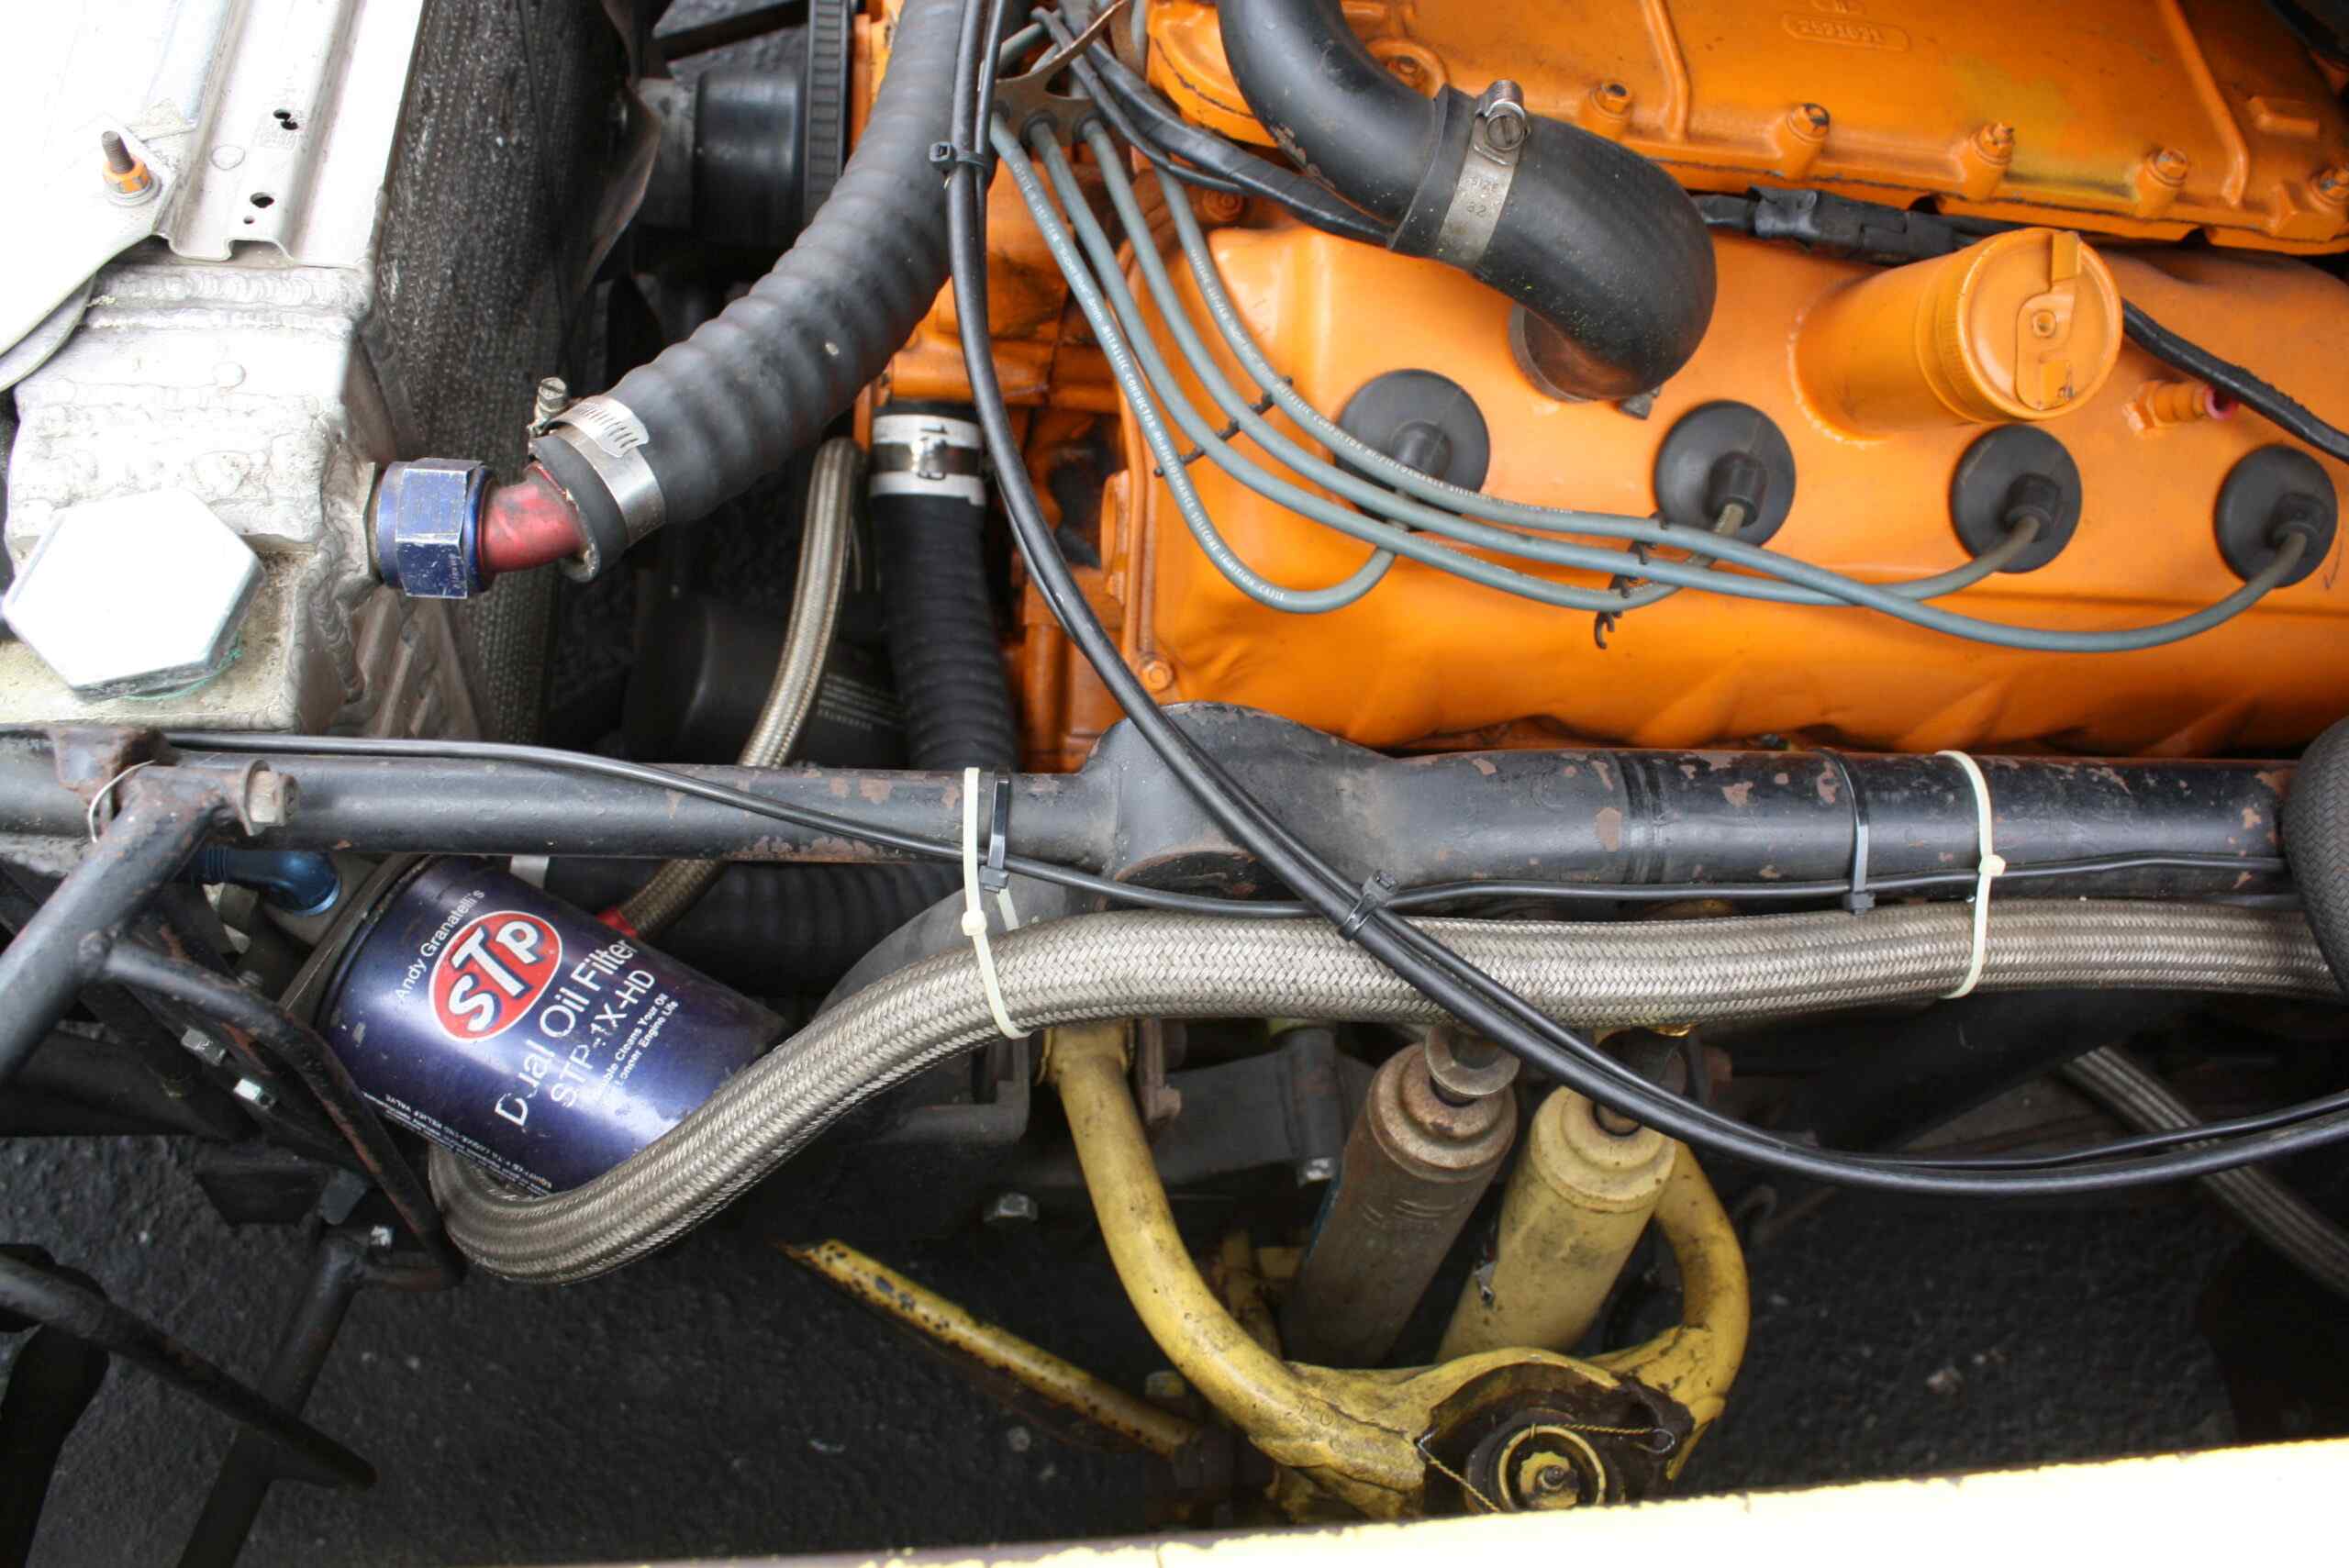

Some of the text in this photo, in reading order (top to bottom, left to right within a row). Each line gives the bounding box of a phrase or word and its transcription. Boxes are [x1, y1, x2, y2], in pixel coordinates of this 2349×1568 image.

[1098, 323, 1130, 371] METALLIC
[1121, 372, 1157, 428] CONDUCTOR
[1190, 509, 1221, 552] SILICONE
[1217, 551, 1256, 587] IGNITION
[1256, 582, 1286, 602] CABLE
[394, 889, 485, 1000] Andy Granatelli's
[448, 920, 541, 1032] STP
[494, 1040, 556, 1127] Dual
[540, 986, 591, 1038] Oil
[570, 939, 639, 992] Filter
[614, 1027, 643, 1062] Cleans
[636, 1005, 659, 1027] Your
[637, 1016, 668, 1049] Engine
[661, 1000, 680, 1017] Life
